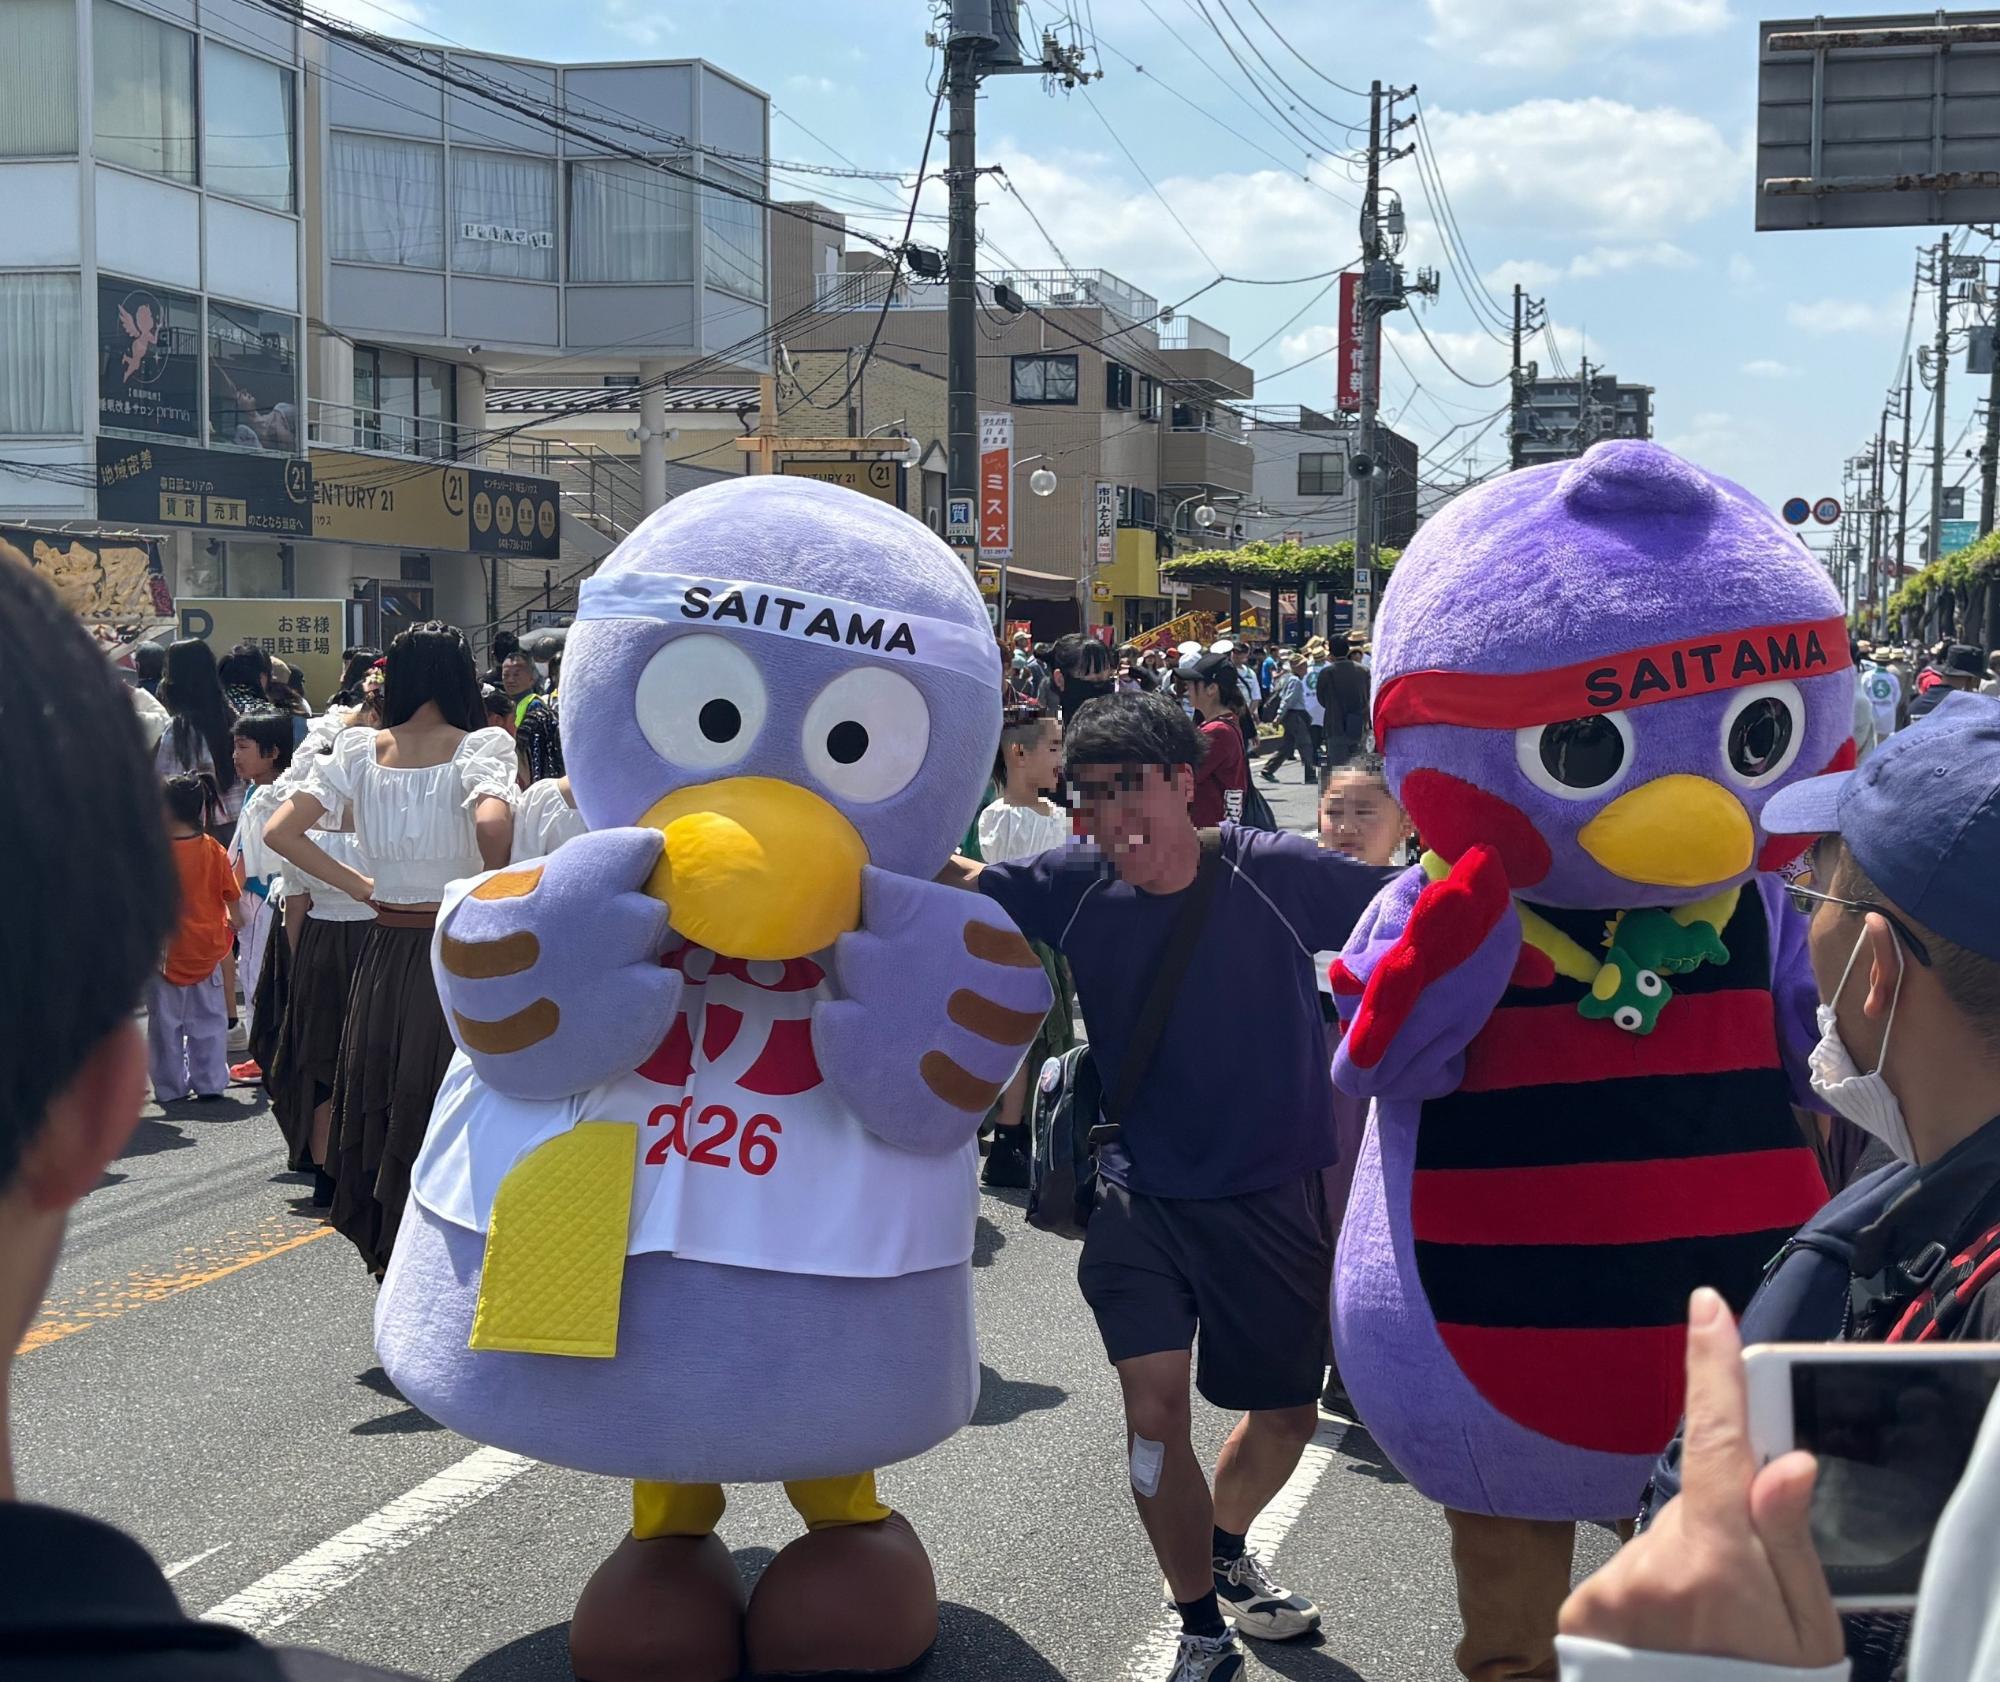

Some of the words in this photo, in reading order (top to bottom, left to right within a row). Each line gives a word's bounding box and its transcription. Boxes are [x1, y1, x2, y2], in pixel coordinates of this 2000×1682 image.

[101, 448, 153, 486] 地域密着
[292, 466, 306, 491] 21
[846, 474, 856, 483] 21
[876, 466, 890, 480] 21
[312, 480, 377, 510] ENTURY
[380, 490, 394, 512] 21
[450, 475, 462, 501] 21
[952, 504, 967, 522] 質
[986, 474, 1006, 542] ミスズ
[1098, 488, 1110, 537] 市川ふとん店
[1819, 506, 1834, 518] 40
[248, 514, 304, 531] のことなら当店へ
[181, 608, 214, 640] P
[278, 616, 330, 634] お客様
[680, 587, 916, 655] SAITAMA
[1585, 630, 1827, 707] SAITAMA
